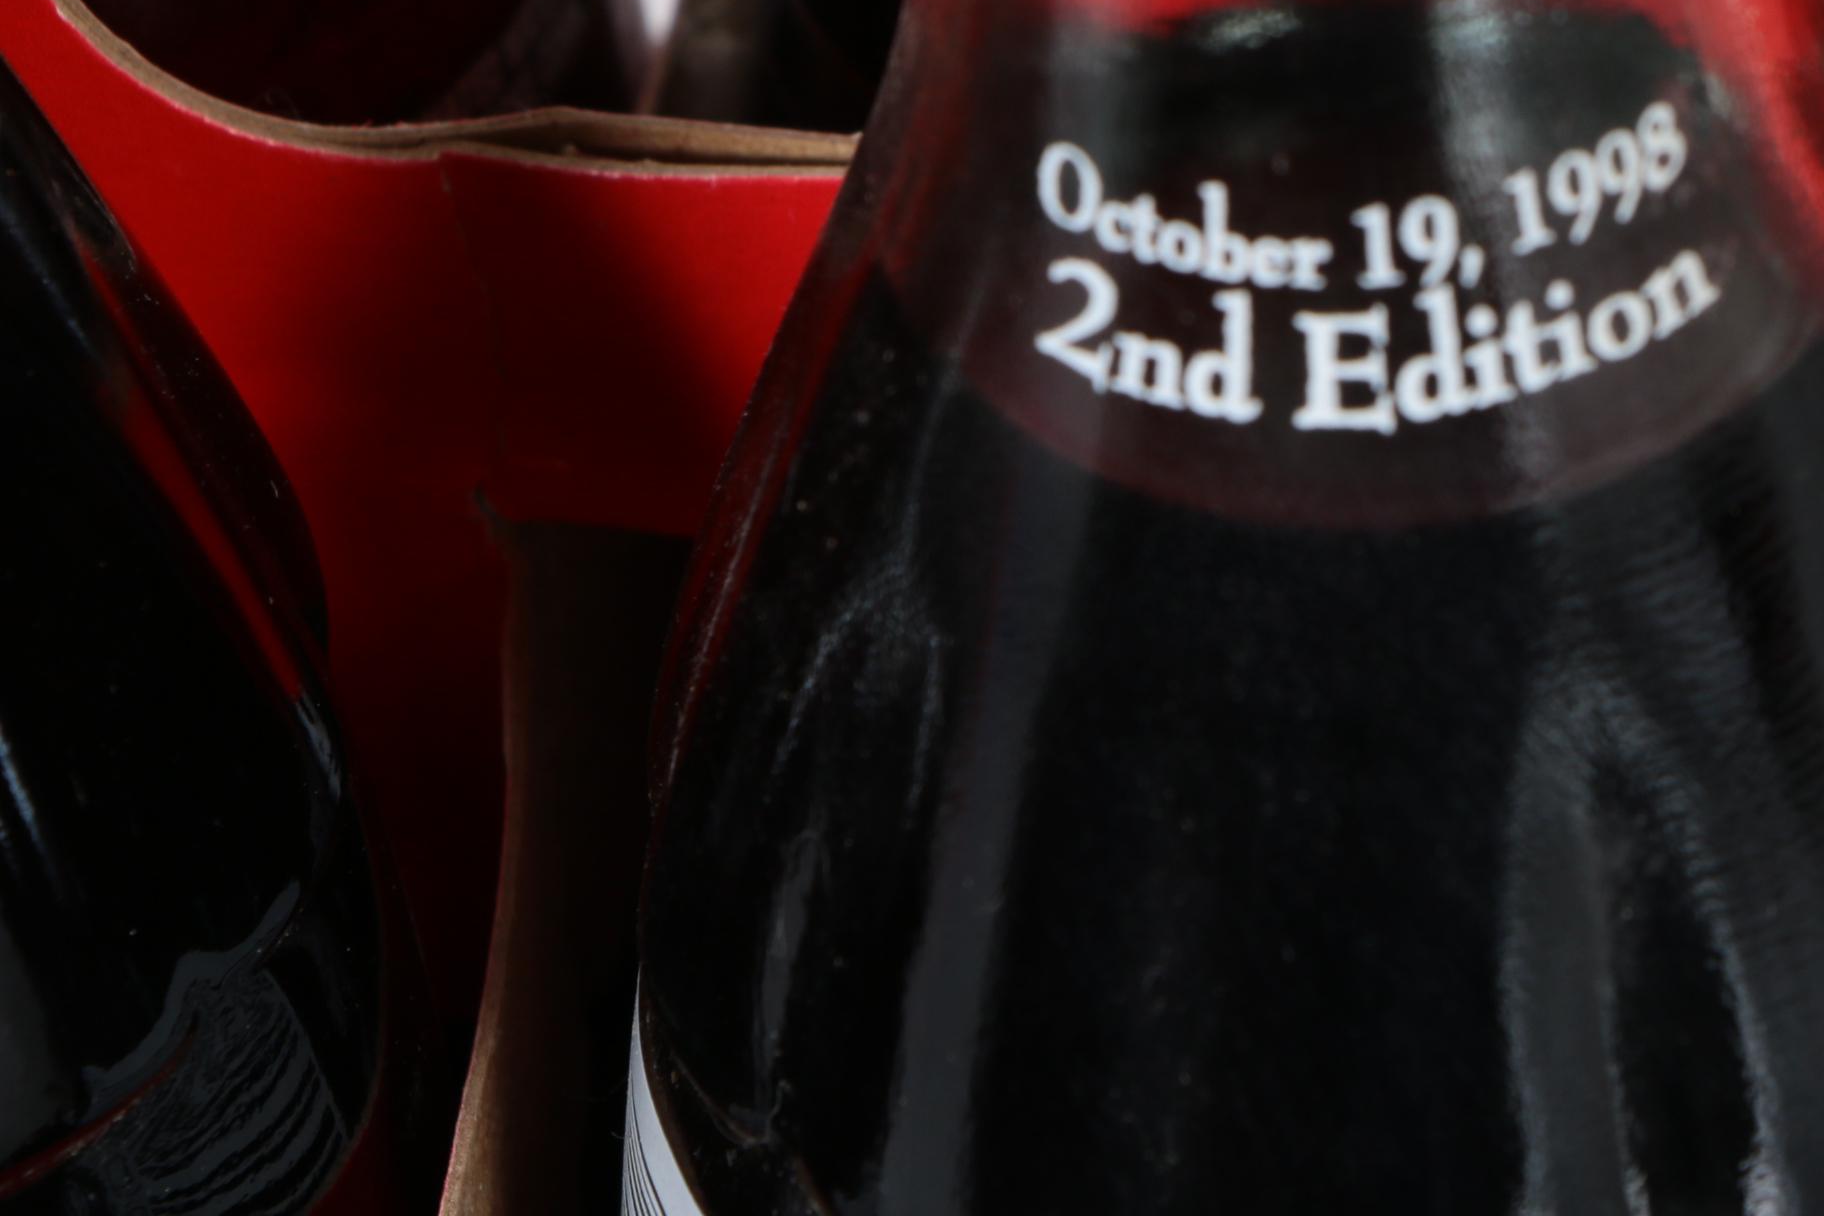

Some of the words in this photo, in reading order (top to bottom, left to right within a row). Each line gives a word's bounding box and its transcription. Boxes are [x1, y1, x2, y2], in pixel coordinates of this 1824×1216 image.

[1036, 141, 1333, 291] October
[1351, 195, 1484, 287] 19,
[1503, 101, 1688, 256] 1998
[1034, 257, 1263, 424] 2nd
[1292, 249, 1721, 436] Edition
